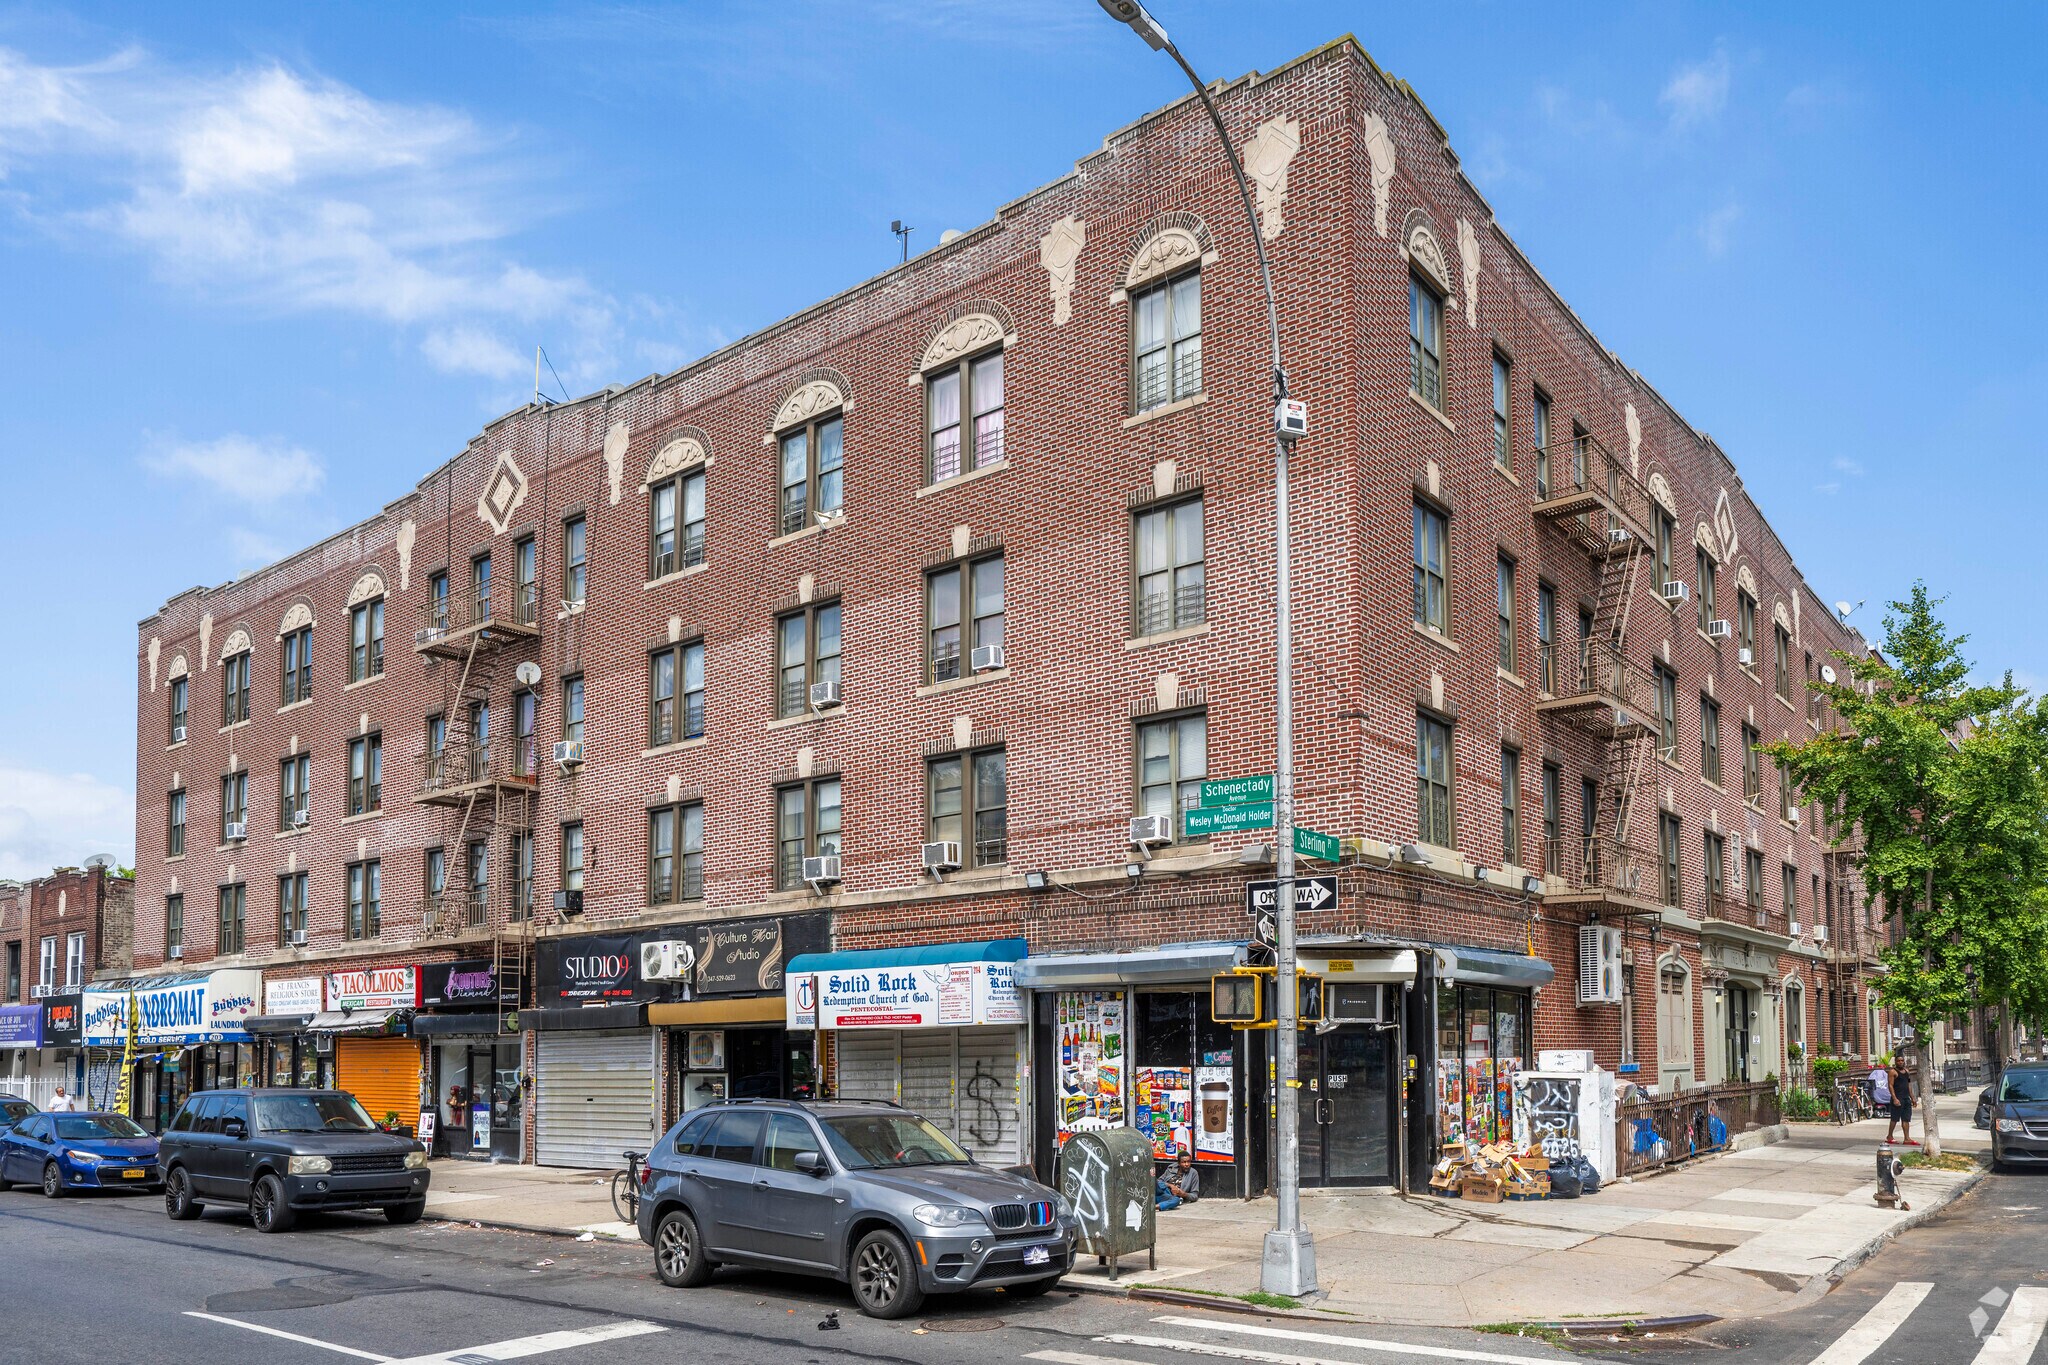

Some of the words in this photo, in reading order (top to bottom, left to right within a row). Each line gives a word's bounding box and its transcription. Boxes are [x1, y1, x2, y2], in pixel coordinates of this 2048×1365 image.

[1205, 778, 1270, 797] Schenectady
[1189, 817, 1212, 828] Wesley
[1214, 812, 1246, 824] McDonald
[1248, 810, 1271, 821] Holder
[1300, 832, 1326, 858] Sterling
[1296, 888, 1323, 901] WAY
[1262, 920, 1274, 938] ONE
[726, 948, 760, 964] Studio
[986, 964, 1013, 977] Soli
[342, 971, 404, 994] TACOLMOS
[829, 974, 870, 994] Solid
[877, 971, 917, 992] Rock
[300, 989, 318, 997] STORE
[823, 996, 868, 1007] Redemption
[869, 994, 898, 1005] Church
[900, 993, 910, 1003] of
[121, 988, 205, 1030] LUNDROMAT
[212, 995, 251, 1012] Bubbles
[85, 1001, 118, 1029] Bubbles
[210, 1020, 244, 1029] LAUNDROM
[158, 1035, 187, 1043] SERVICE
[1213, 1051, 1232, 1064] Coffee
[1206, 1105, 1223, 1115] Coffee
